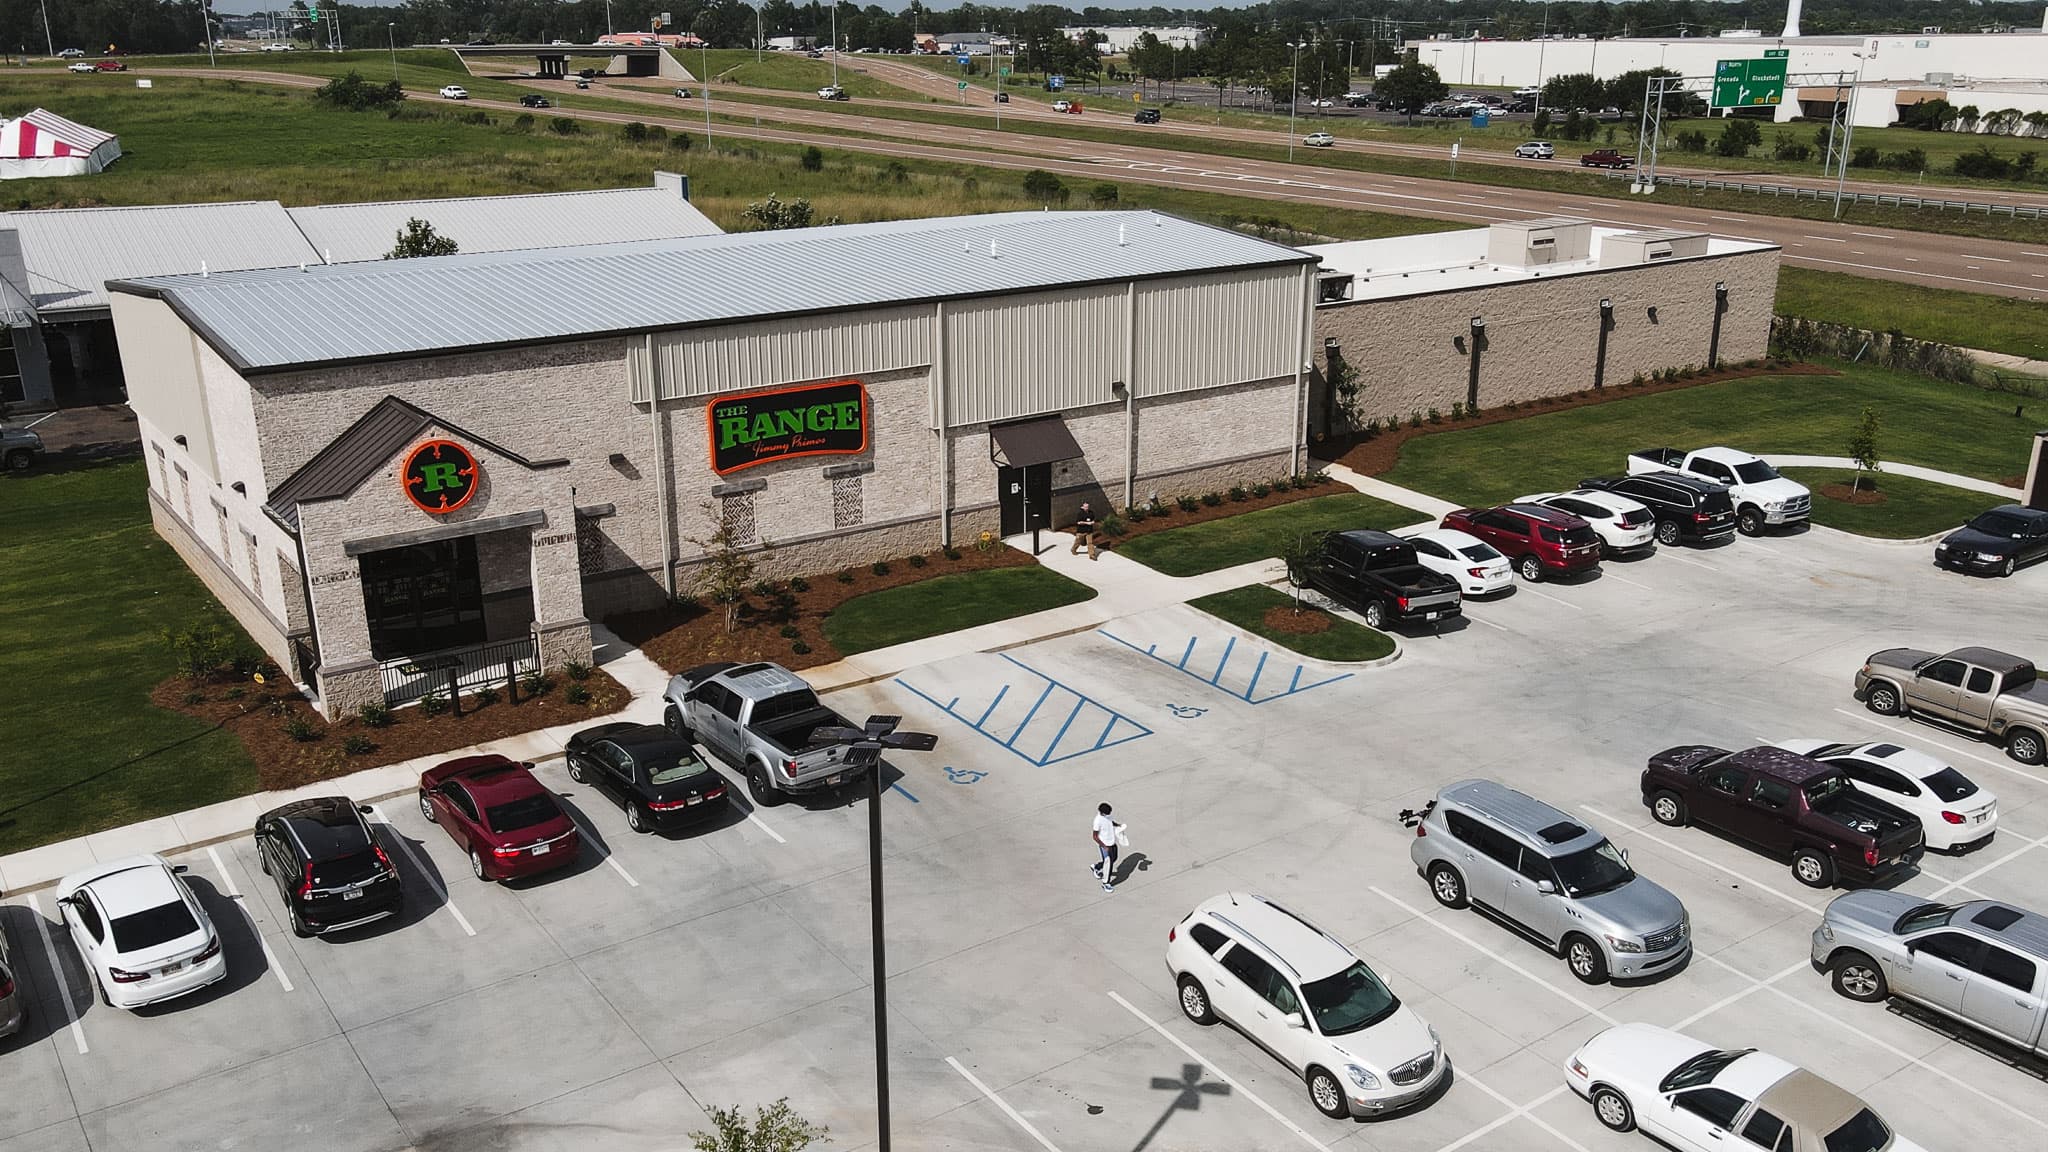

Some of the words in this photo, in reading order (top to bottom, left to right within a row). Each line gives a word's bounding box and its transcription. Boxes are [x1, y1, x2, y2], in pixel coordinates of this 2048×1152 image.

[716, 405, 748, 418] THE
[719, 400, 860, 450] RANGE
[752, 440, 790, 458] Jimmy
[792, 435, 827, 448] Primos
[420, 462, 464, 493] R
